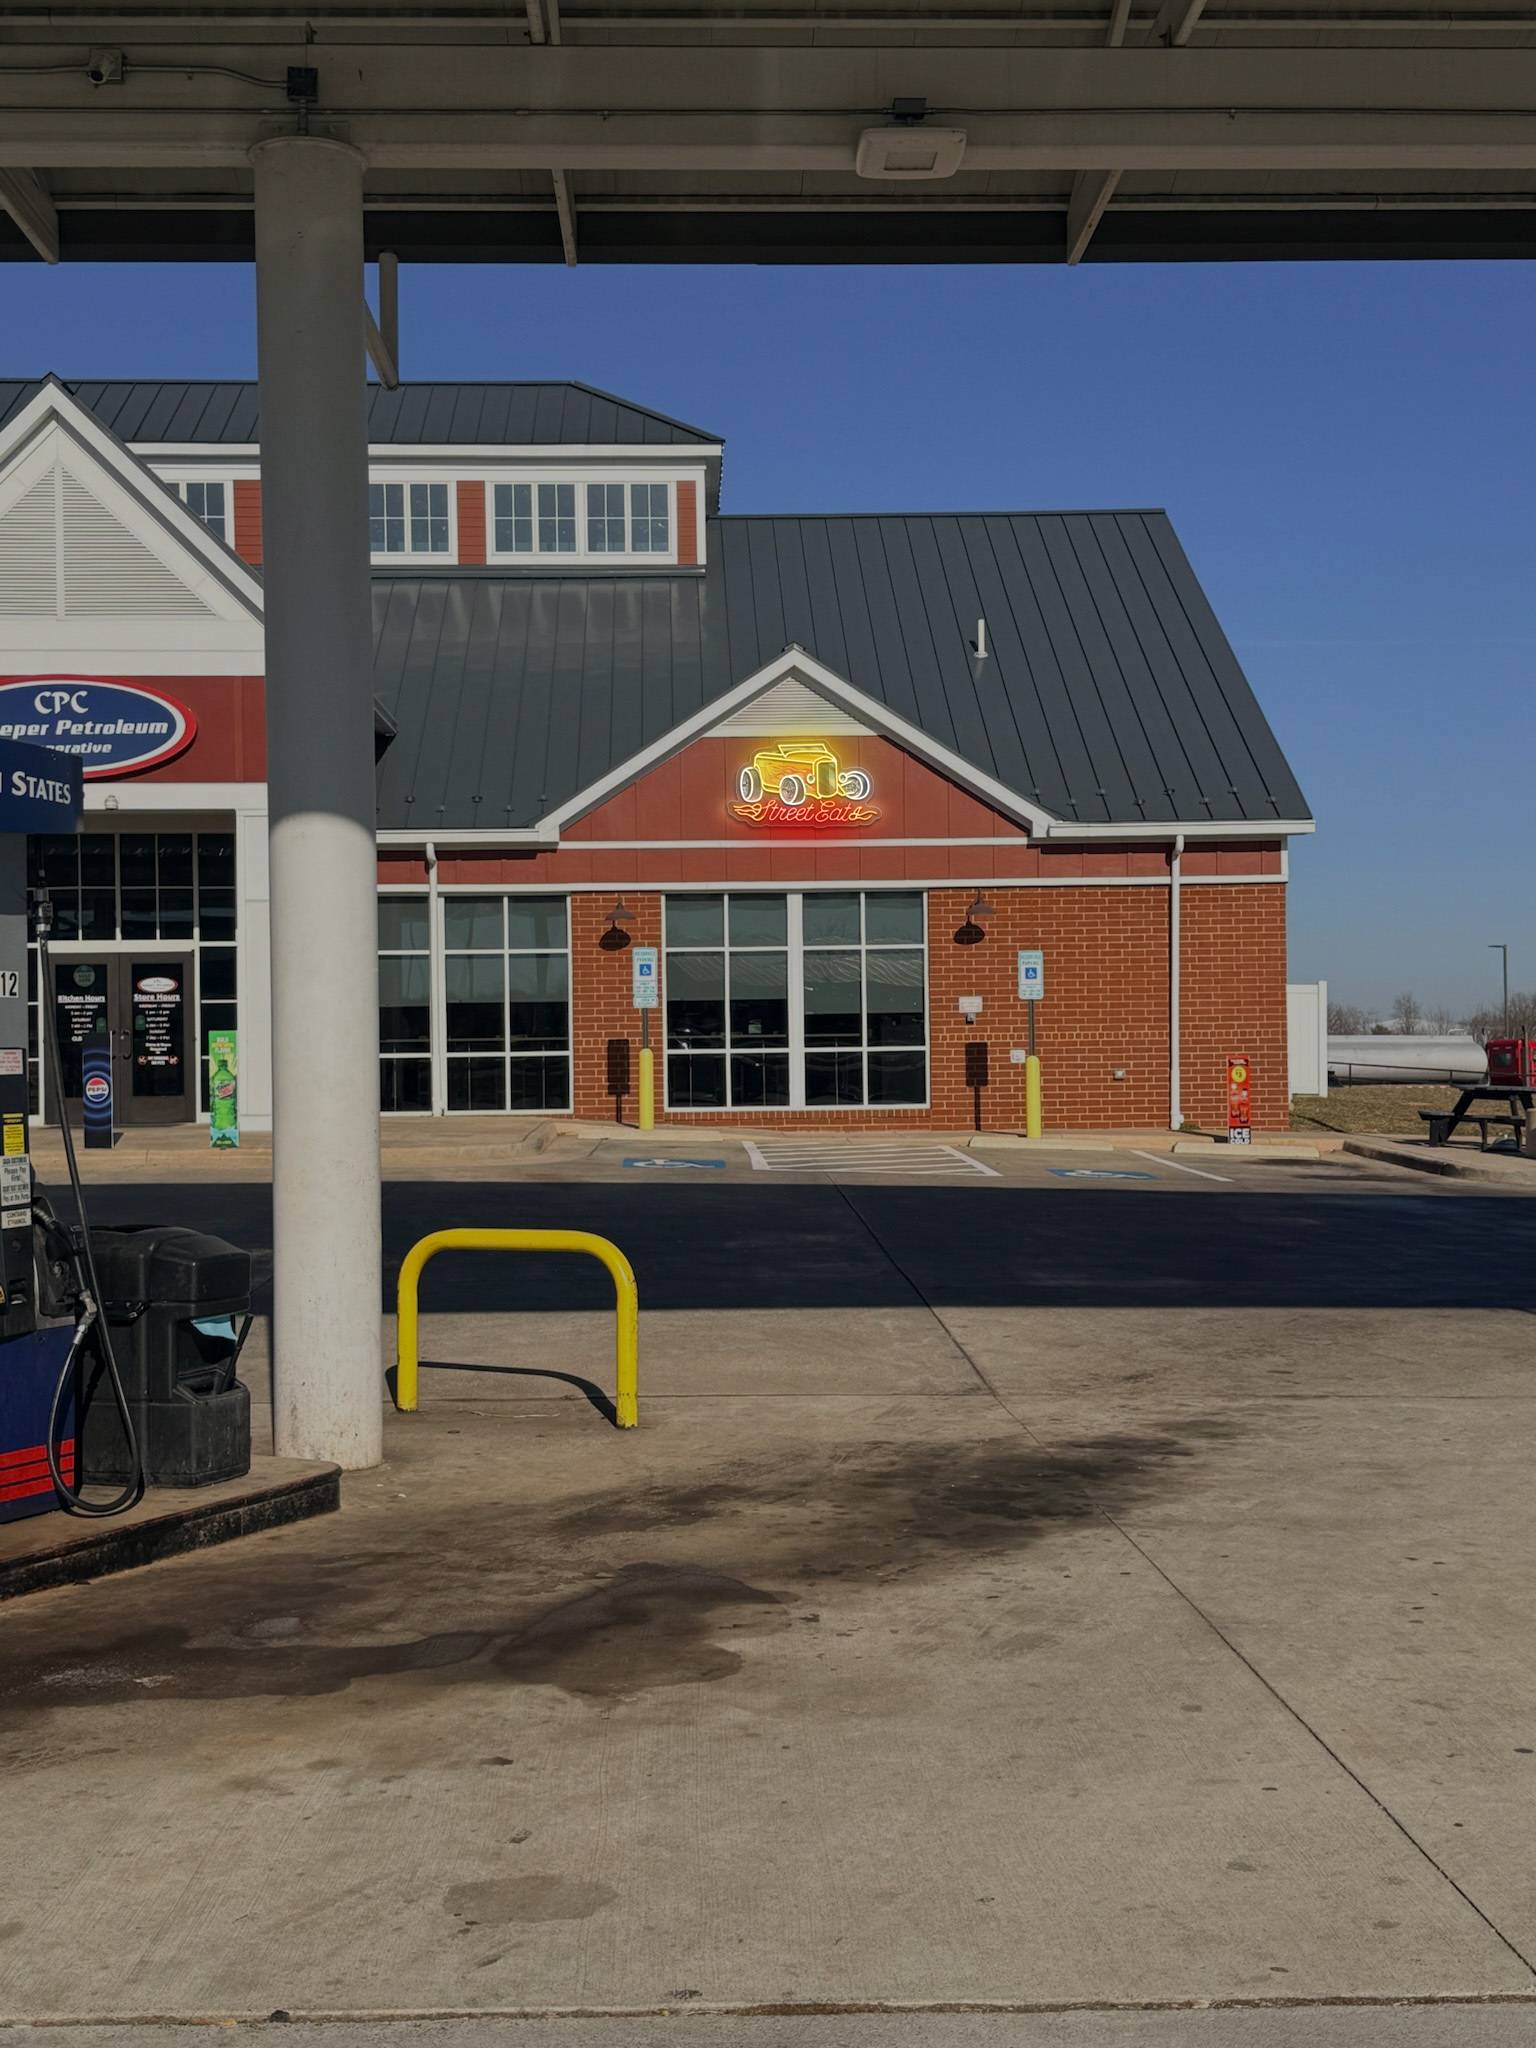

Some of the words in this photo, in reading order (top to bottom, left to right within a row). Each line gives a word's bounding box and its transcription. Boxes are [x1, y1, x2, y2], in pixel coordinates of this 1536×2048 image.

[34, 690, 89, 714] CPC
[55, 719, 169, 736] Petroleum
[45, 743, 113, 754] erative
[752, 800, 815, 822] Street
[815, 801, 865, 822] Eats
[1, 972, 17, 996] 12
[57, 995, 84, 1003] Kitchen
[84, 995, 106, 1003] Hours
[133, 993, 156, 1002] Store
[156, 993, 181, 1002] Hours
[1230, 1128, 1250, 1138] ICE
